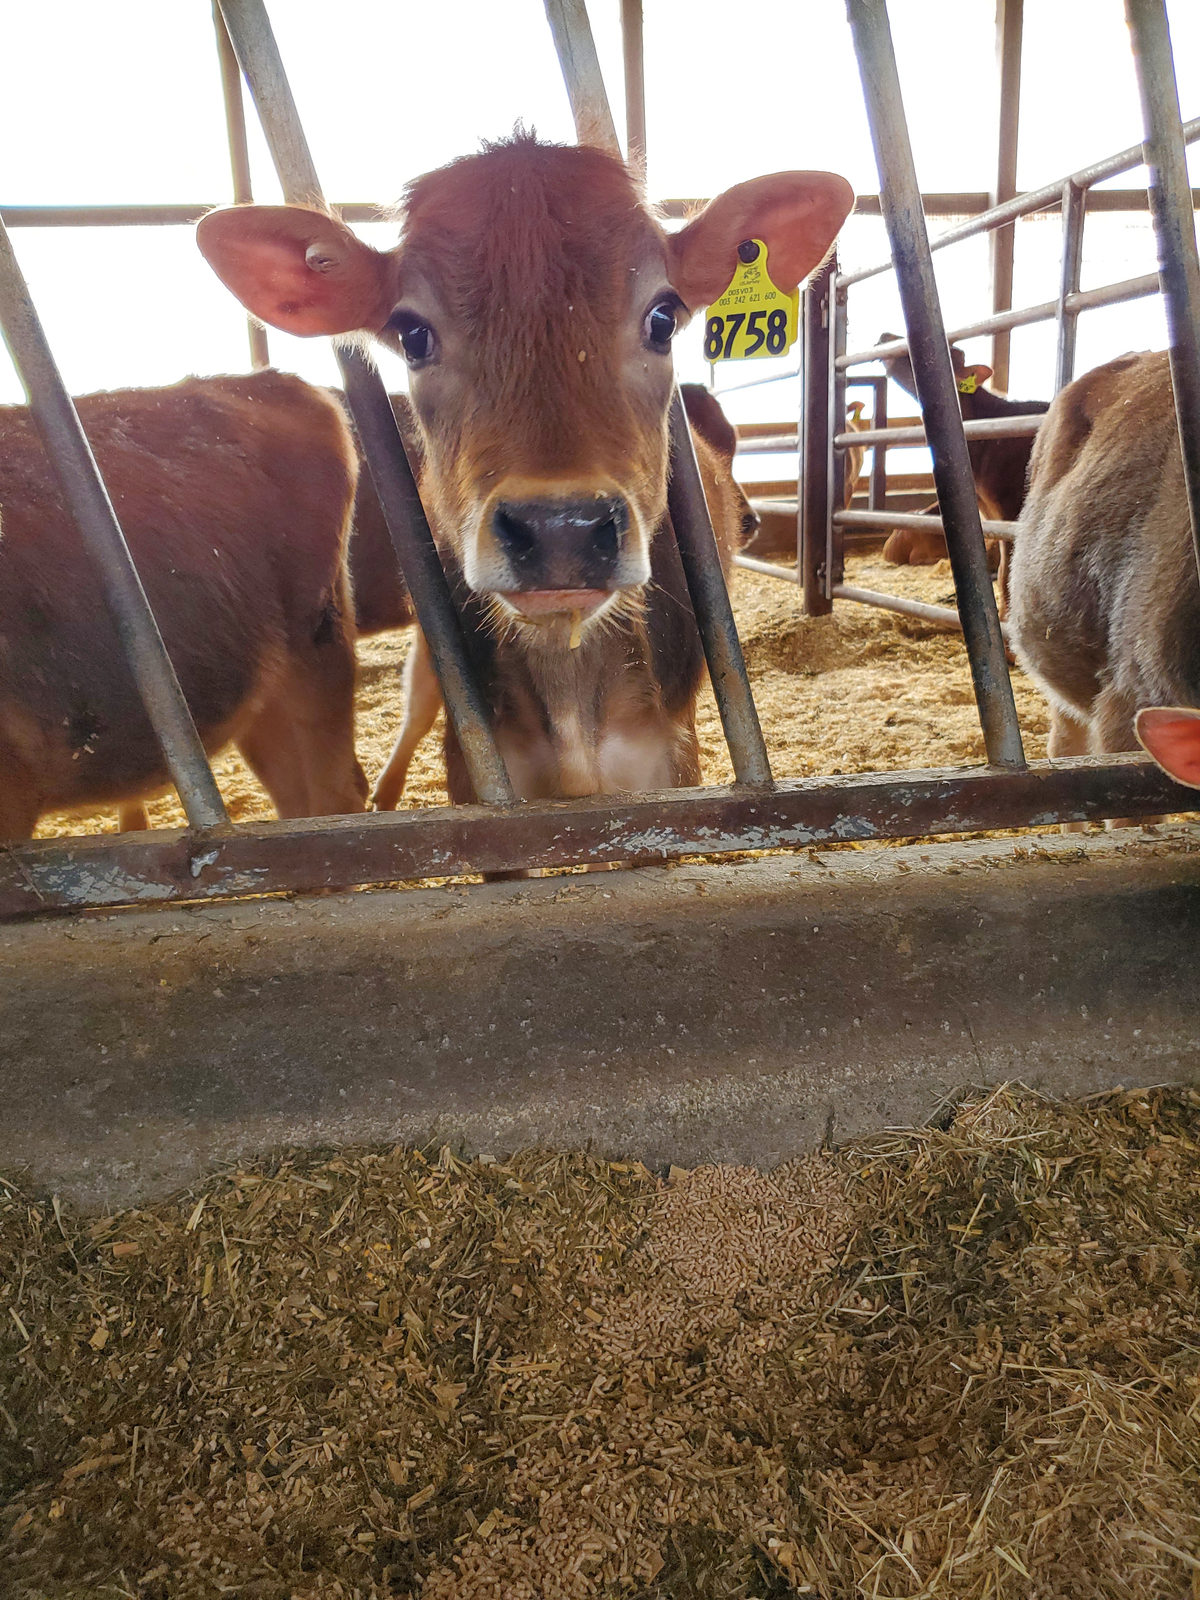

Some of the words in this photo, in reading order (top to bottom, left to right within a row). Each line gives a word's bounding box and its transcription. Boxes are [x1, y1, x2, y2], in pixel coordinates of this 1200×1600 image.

[734, 296, 745, 304] 242
[749, 294, 760, 302] 621
[764, 291, 776, 300] 600
[704, 309, 787, 359] 8758
